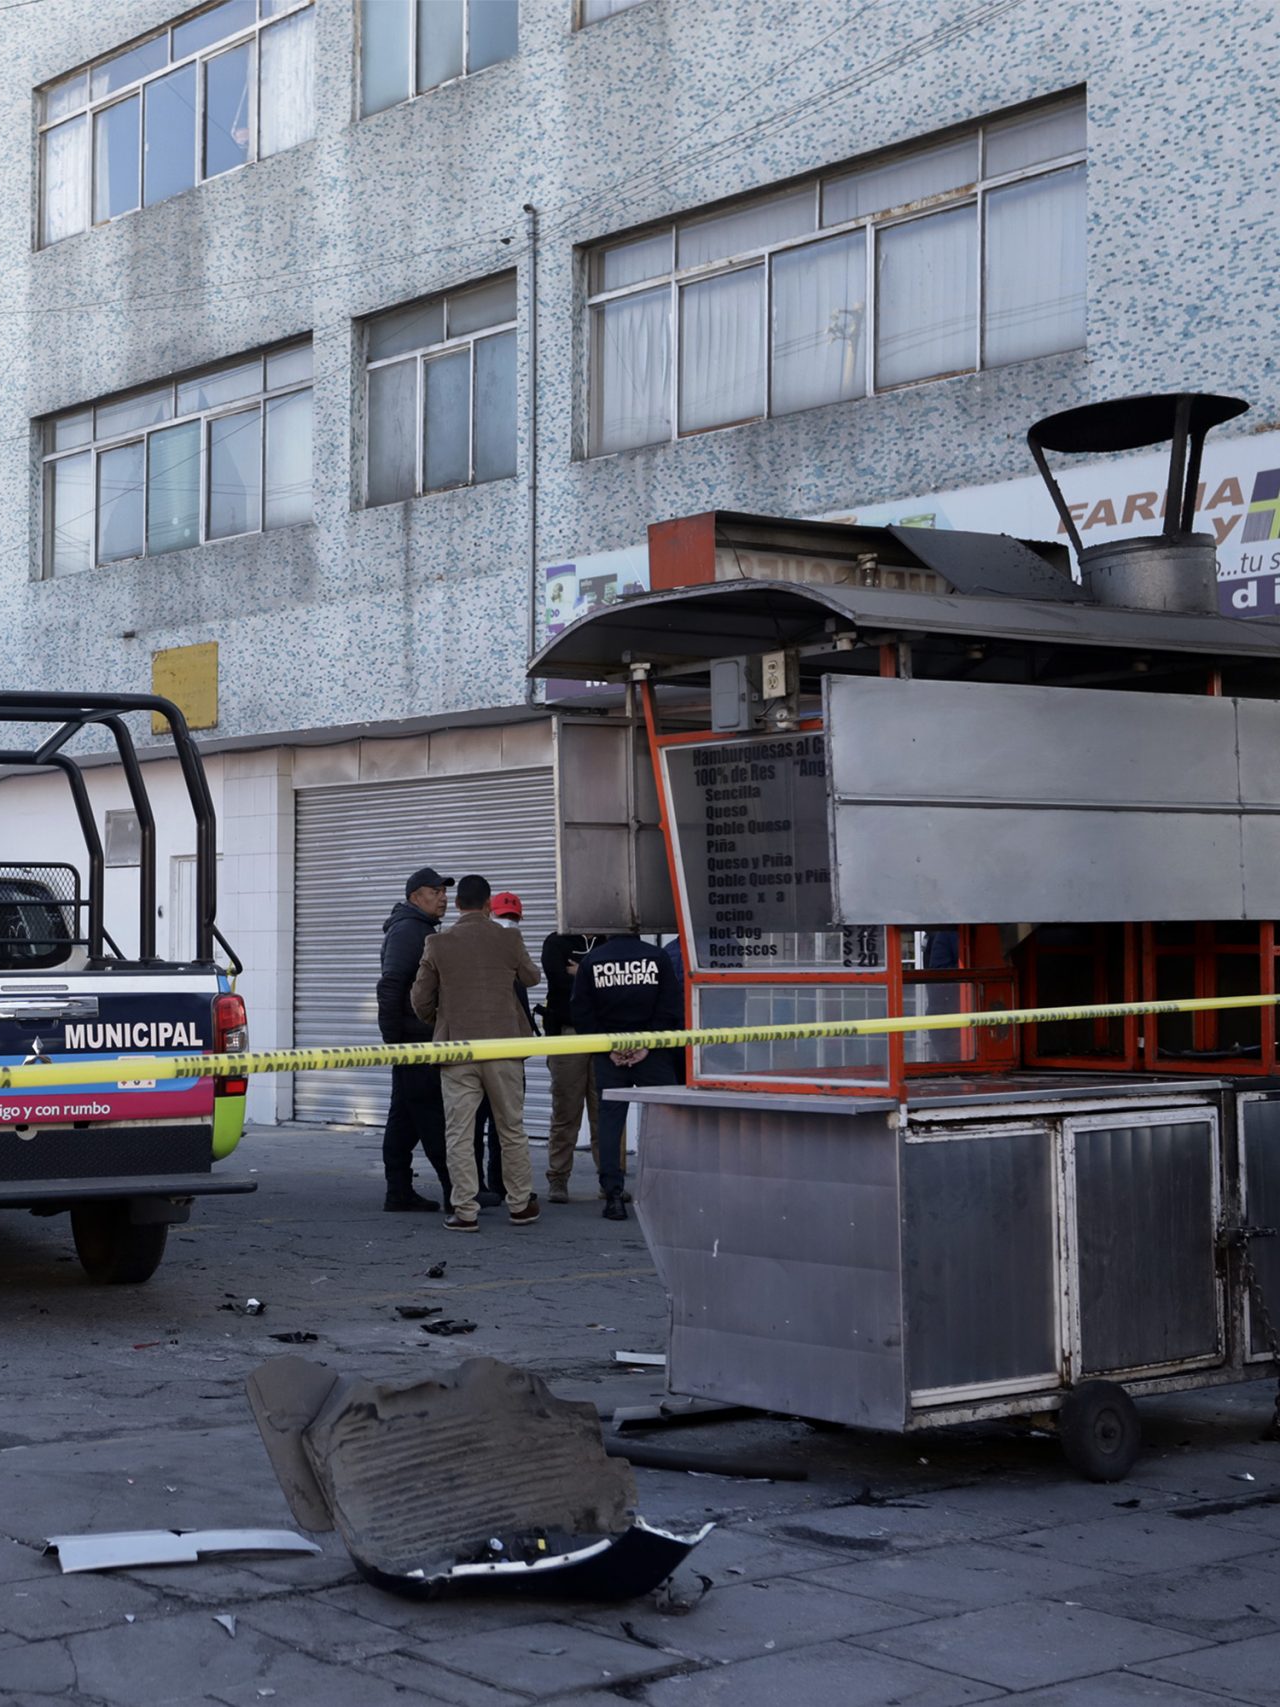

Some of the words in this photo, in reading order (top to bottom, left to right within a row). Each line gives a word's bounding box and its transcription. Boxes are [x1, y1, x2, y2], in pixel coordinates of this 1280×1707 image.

[693, 741, 793, 766] Hamburguesas
[796, 738, 810, 757] al
[695, 767, 728, 787] 100%
[731, 765, 747, 783] de
[751, 763, 776, 782] Res
[705, 785, 761, 802] Sencilla
[706, 804, 748, 820] Queso
[706, 821, 745, 837] Doble
[748, 818, 792, 834] Queso
[707, 839, 736, 853] Piña
[707, 855, 749, 872] Queso
[752, 857, 759, 870] y
[762, 853, 793, 867] Piña
[708, 873, 745, 888] Doble
[749, 870, 792, 886] Queso
[795, 872, 802, 885] y
[708, 891, 748, 905] Carne
[709, 925, 762, 940] Hot-Dog
[710, 942, 777, 957] Refrescos
[593, 959, 659, 977] POLICÍA
[857, 952, 878, 967] 20
[595, 973, 658, 988] MUNICIPAL
[64, 1021, 204, 1050] MUNICIPAL
[23, 1106, 33, 1119] y
[35, 1104, 61, 1117] con
[63, 1101, 111, 1116] rumbo
